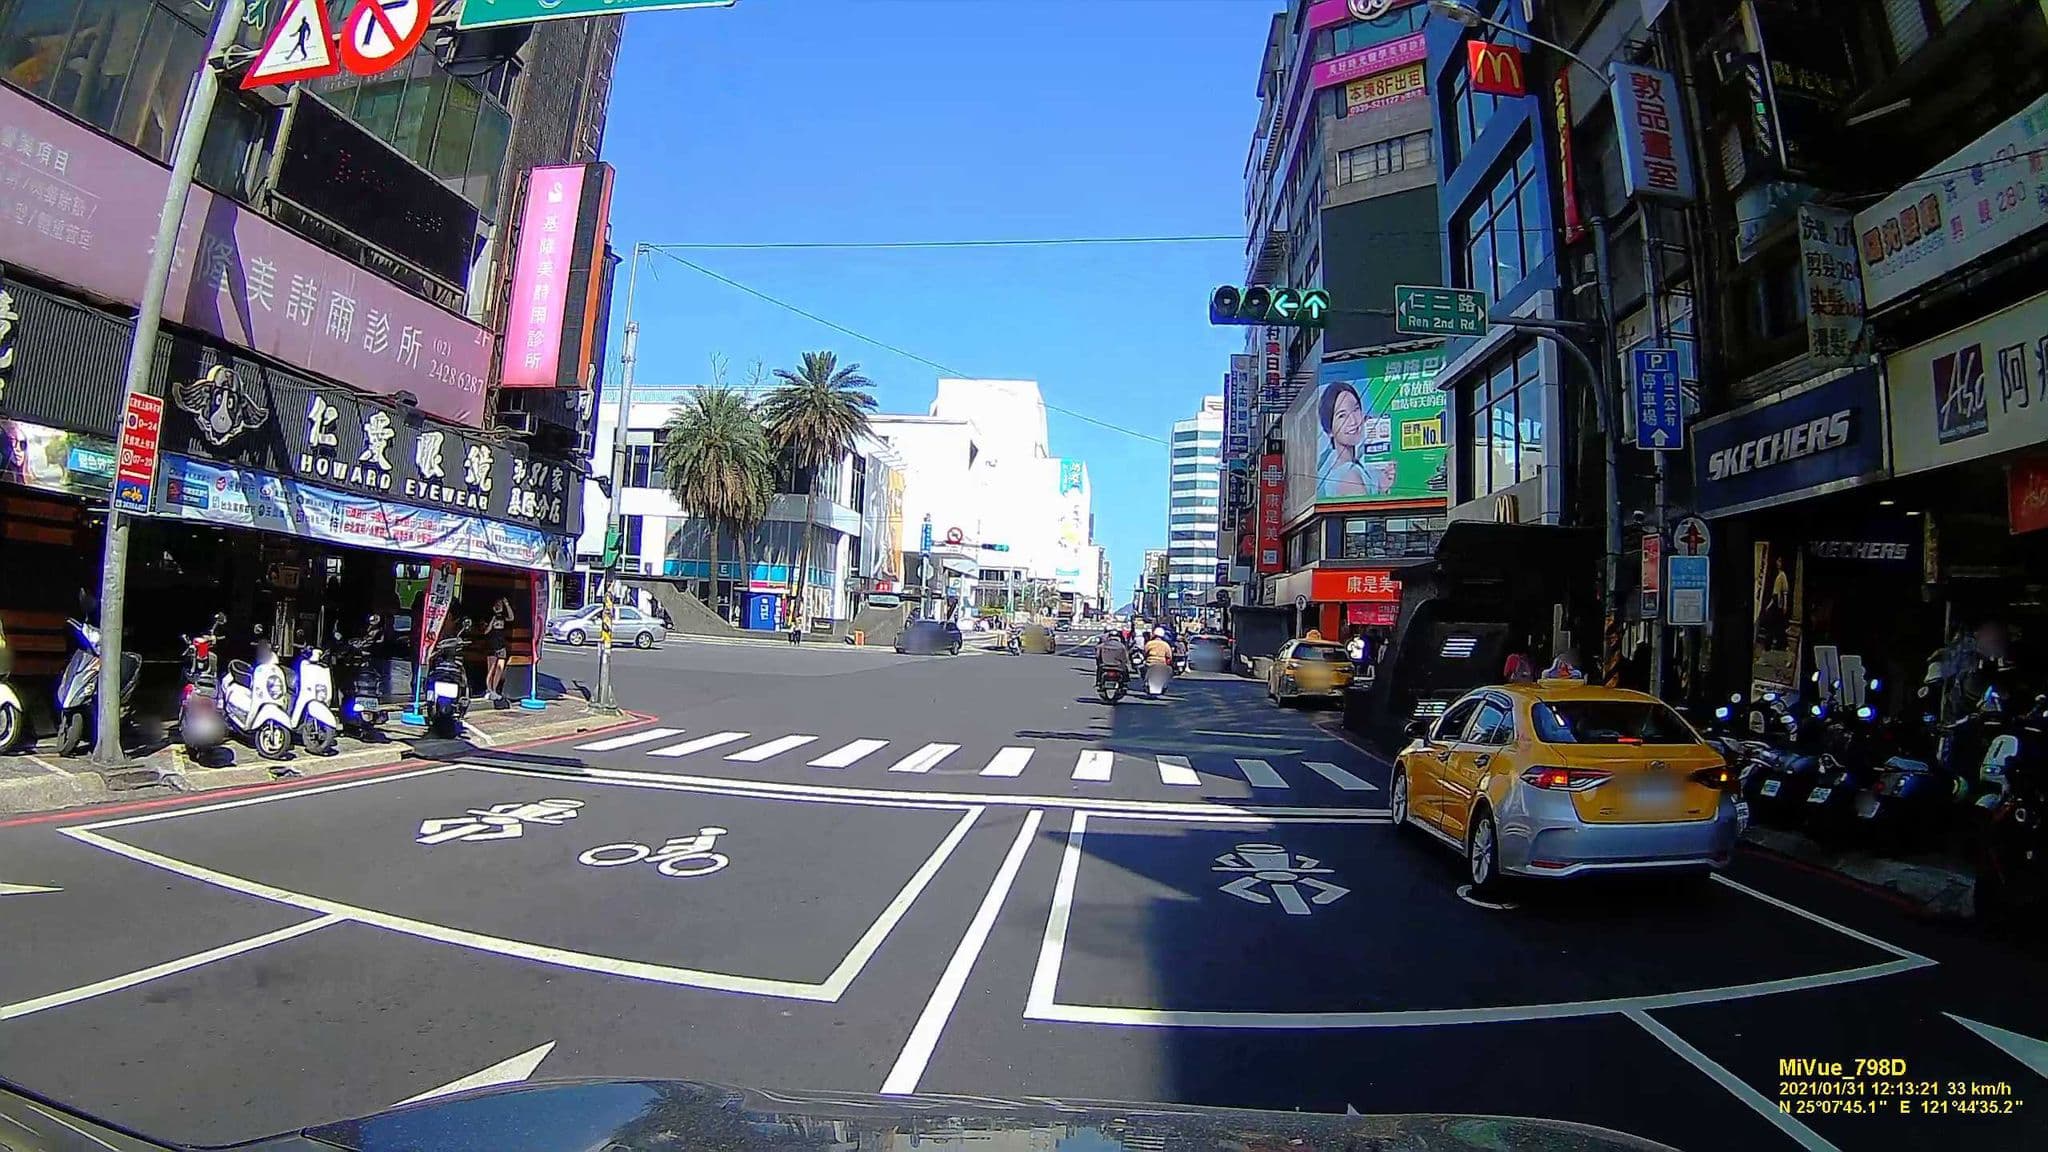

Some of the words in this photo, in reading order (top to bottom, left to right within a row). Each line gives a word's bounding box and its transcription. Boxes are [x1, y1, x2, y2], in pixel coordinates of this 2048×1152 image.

[1407, 293, 1477, 313] 仁二路
[1408, 315, 1429, 329] Ren
[1433, 317, 1454, 330] 2nd
[432, 338, 452, 358] (02)
[1650, 354, 1662, 369] P
[429, 359, 457, 387] 2428
[456, 368, 486, 396] 6287
[1641, 373, 1657, 426] 停車場
[308, 395, 495, 493] 仁愛眼鏡
[1706, 409, 1851, 481] SKECHERS
[300, 453, 392, 491] HOWARD
[406, 478, 490, 512] EYEWEAR
[1346, 575, 1394, 594] 康是美
